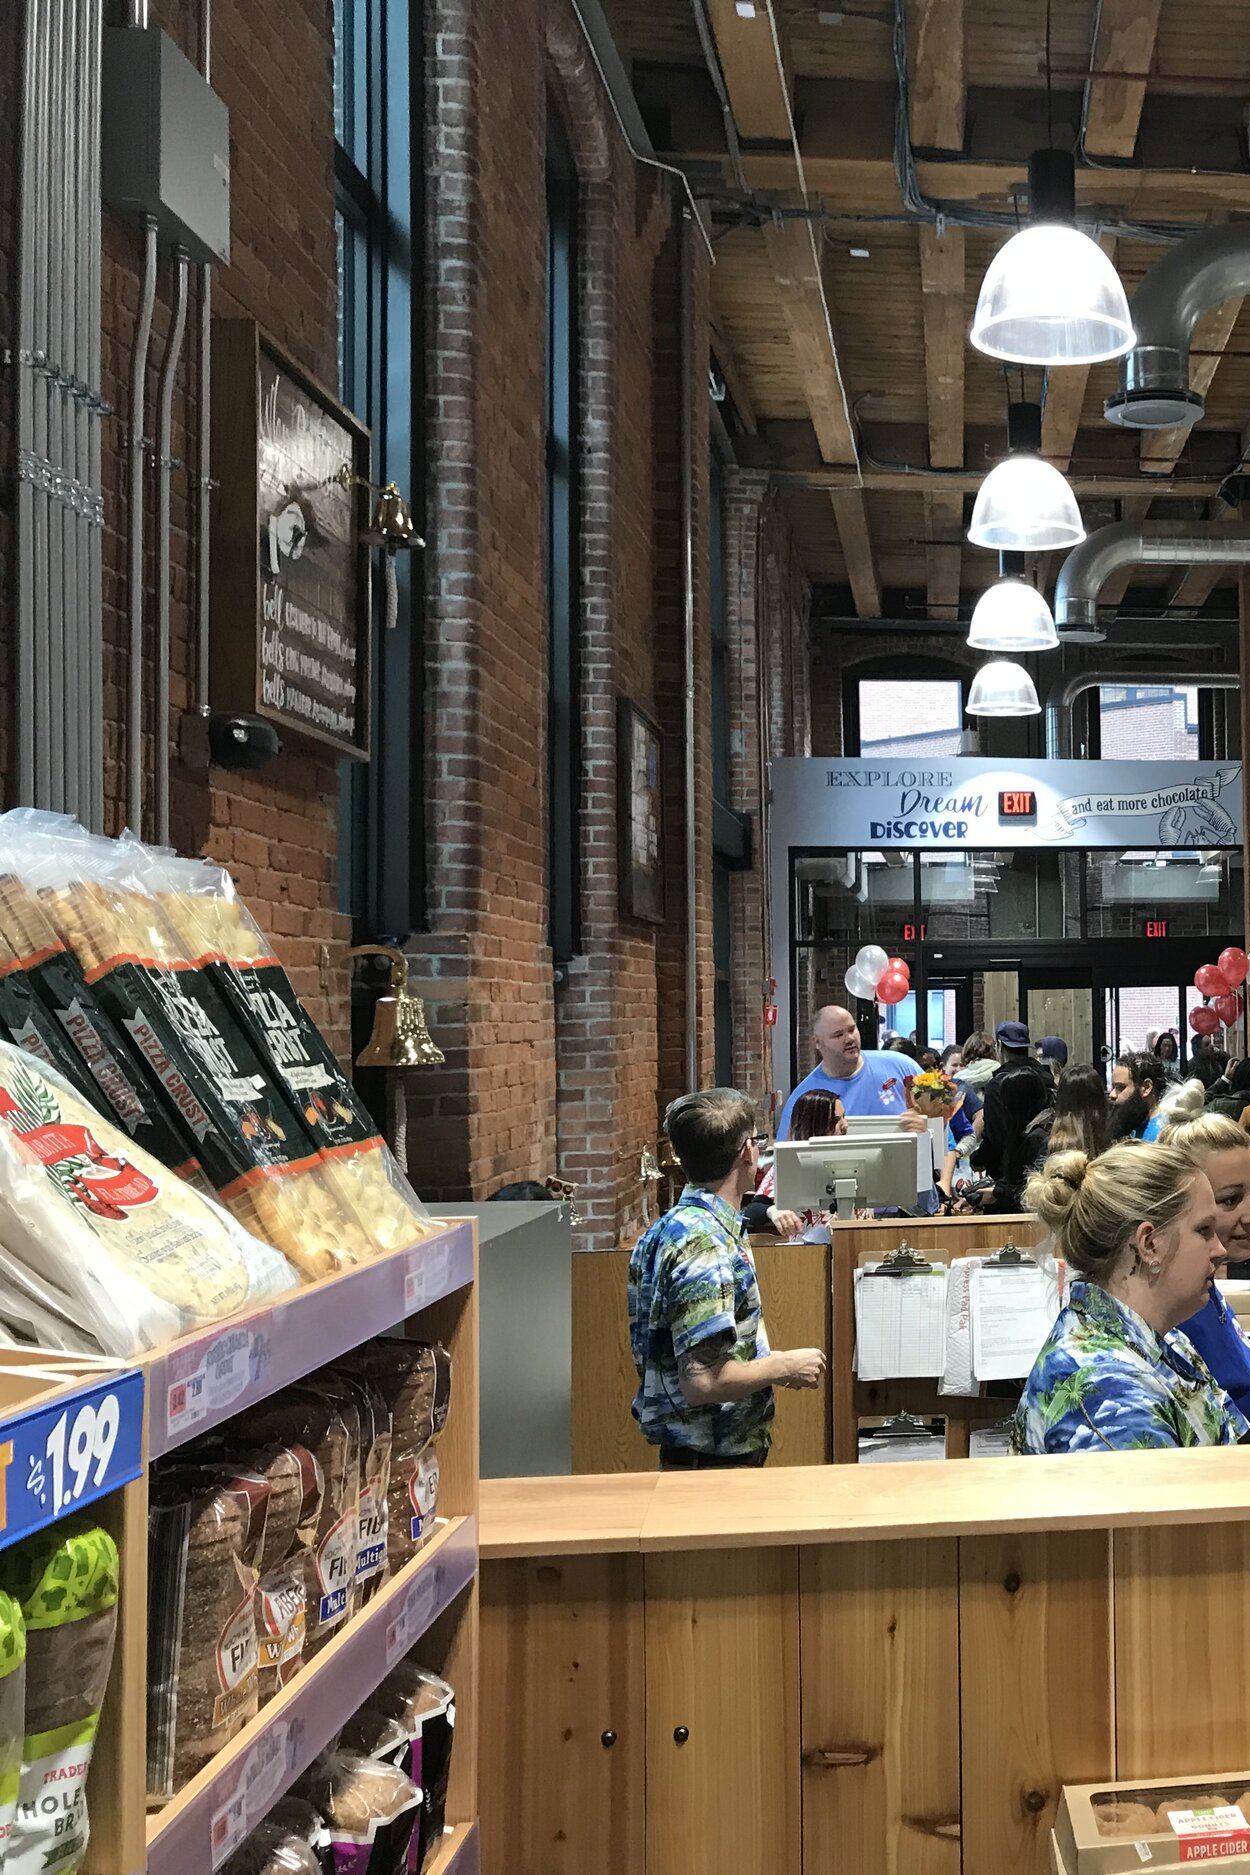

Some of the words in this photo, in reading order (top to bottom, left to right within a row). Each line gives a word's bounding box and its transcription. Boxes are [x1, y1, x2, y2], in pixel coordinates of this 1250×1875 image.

[826, 771, 953, 787] EXPLORE
[893, 788, 988, 818] Dream
[1003, 793, 1031, 813] EXIT
[1072, 798, 1092, 815] and
[1096, 799, 1115, 812] eat
[1117, 798, 1147, 811] more
[1151, 787, 1208, 808] chocolate
[1146, 921, 1167, 937] EXIT
[66, 1014, 106, 1066] PIZZA
[96, 1063, 143, 1118] CRUST
[133, 1024, 173, 1075] PIZZA
[165, 1073, 209, 1127] CRUST
[16, 1787, 82, 1822] HOLE
[1186, 1843, 1218, 1860] APPLE
[1219, 1840, 1249, 1856] CIDER
